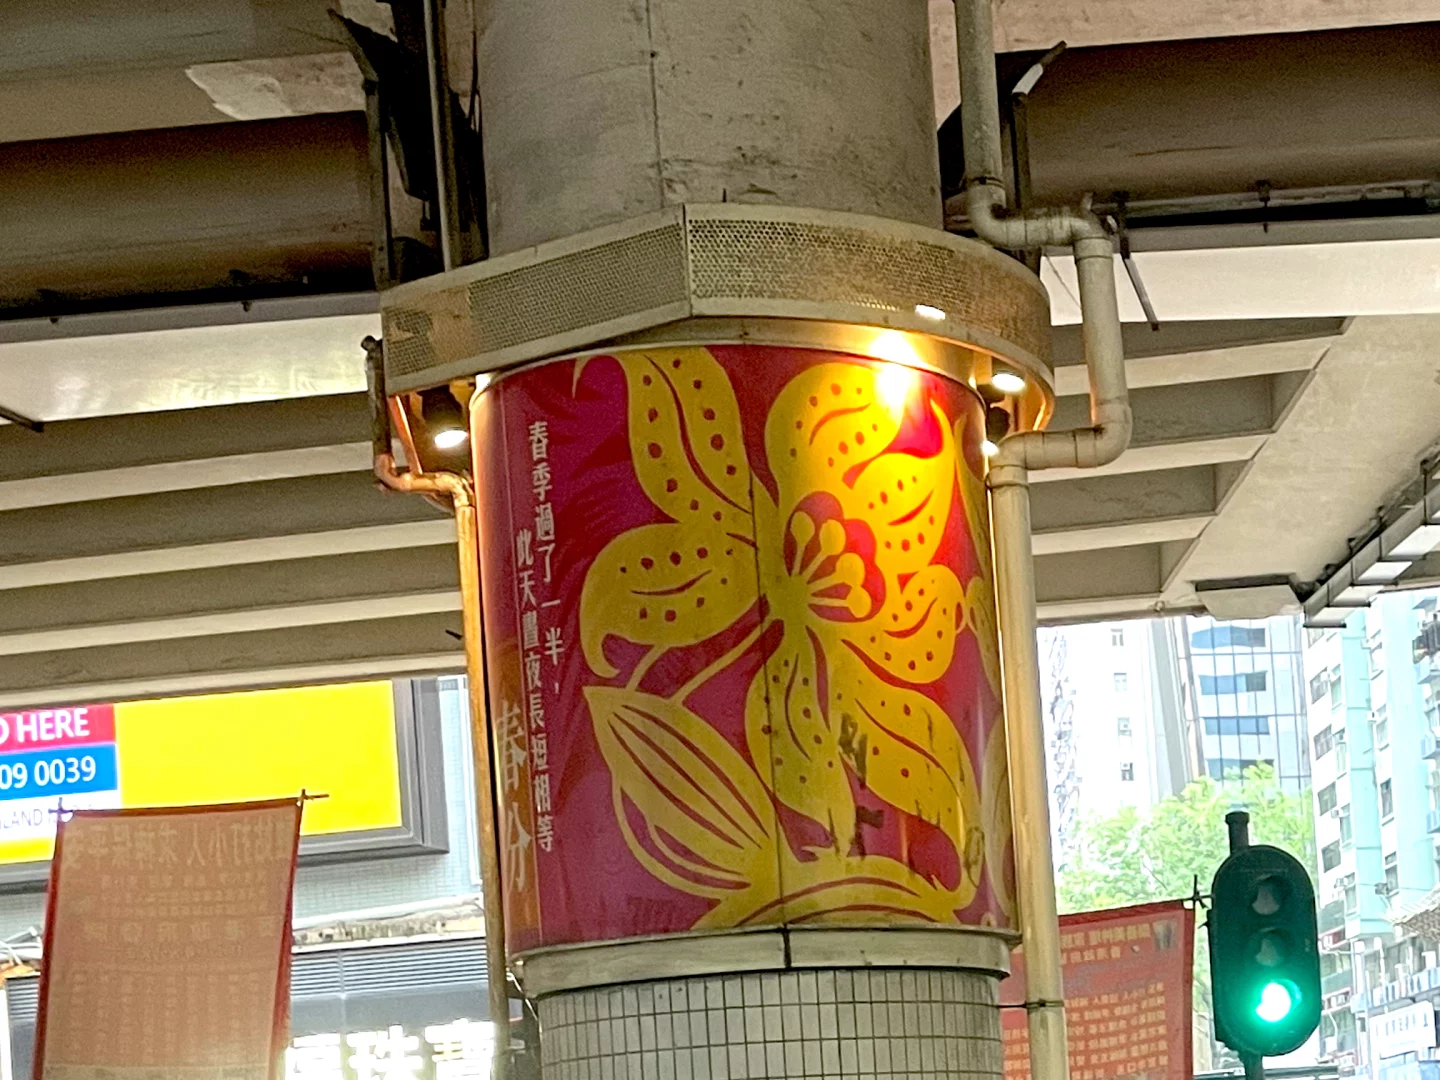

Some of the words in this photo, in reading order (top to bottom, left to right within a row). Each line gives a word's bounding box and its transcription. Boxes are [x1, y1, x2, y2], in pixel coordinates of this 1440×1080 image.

[16, 707, 90, 743] HERE
[34, 755, 96, 787] 0039
[0, 808, 43, 830] LAND
